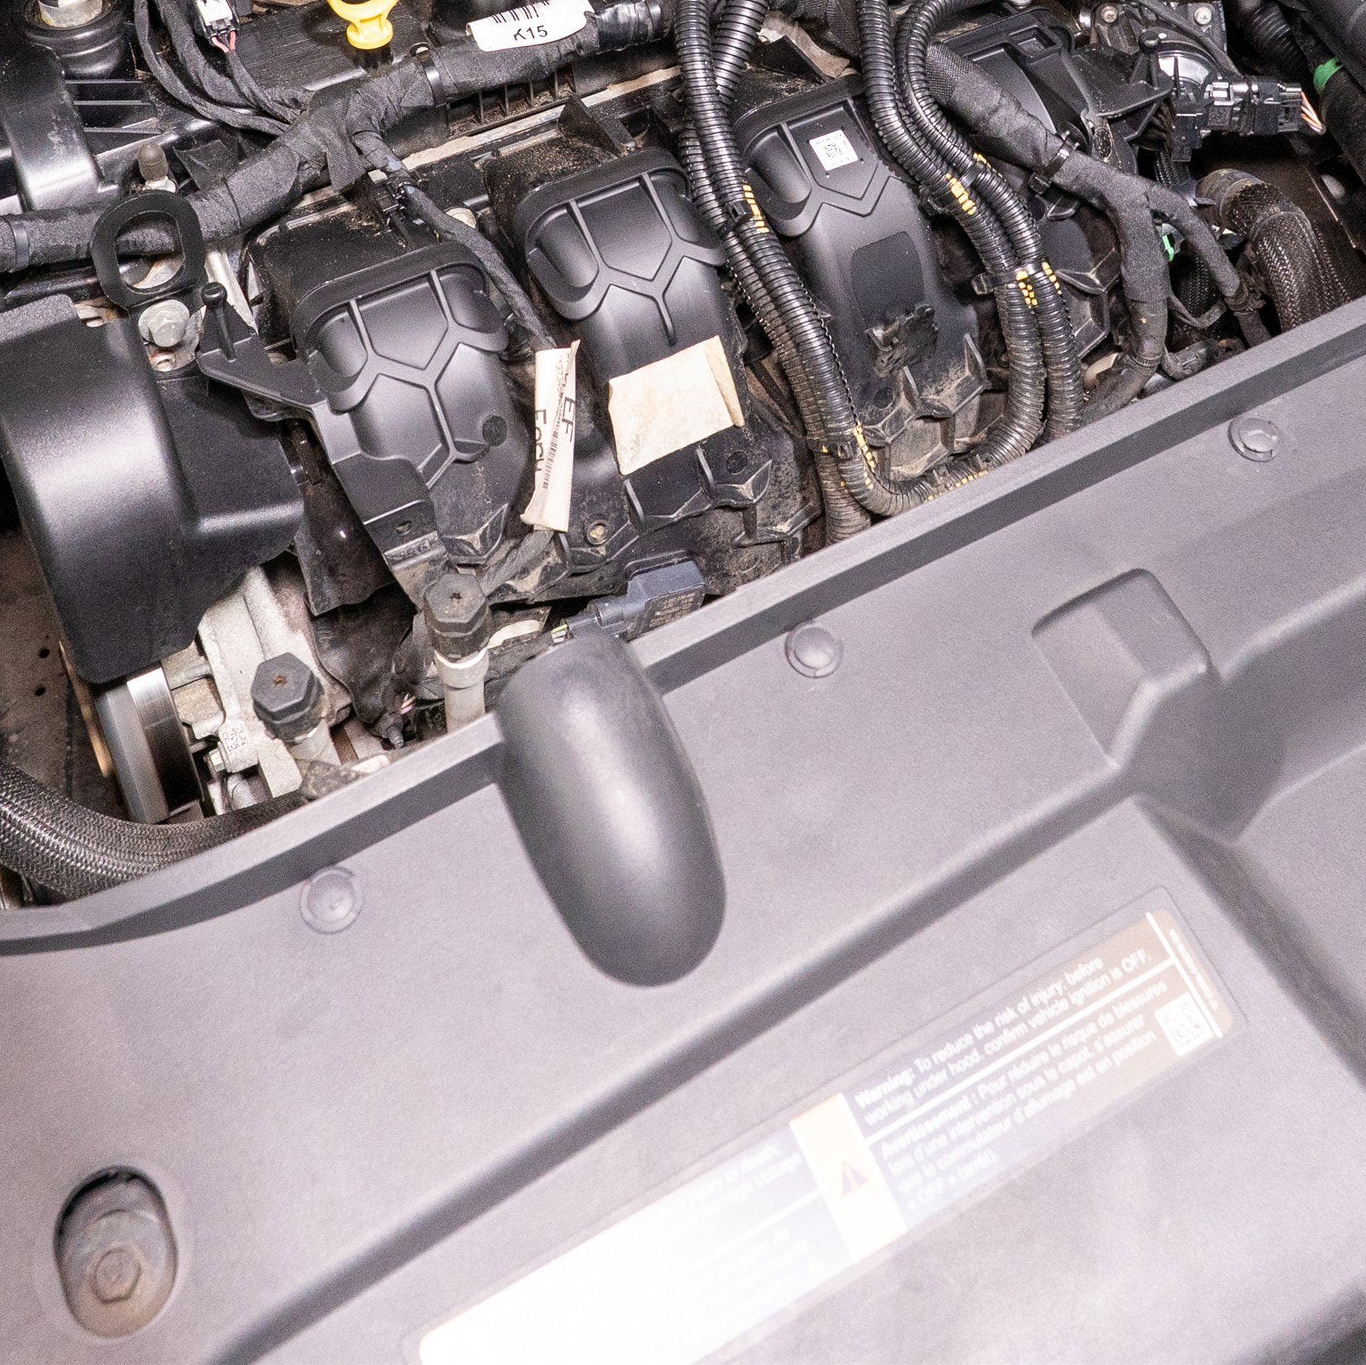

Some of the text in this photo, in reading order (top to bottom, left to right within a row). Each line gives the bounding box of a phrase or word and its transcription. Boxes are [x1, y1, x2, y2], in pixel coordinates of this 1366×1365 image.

[853, 1063, 917, 1113] Warning:
[913, 1054, 932, 1075] To
[929, 1029, 975, 1066] reduce
[971, 1016, 996, 1041] the
[992, 1003, 1018, 1028] risk
[1014, 995, 1033, 1015] of
[1063, 953, 1105, 986] before
[862, 1086, 916, 1131] working
[911, 1066, 950, 1098] under
[981, 1018, 1030, 1057] confirm
[1025, 994, 1071, 1030] vehicle
[1066, 970, 1114, 1009] ignition
[1107, 963, 1124, 981] is
[975, 1071, 1010, 1101] Pour
[1046, 1038, 1063, 1058] le
[1058, 1018, 1100, 1053] risque
[1094, 1007, 1116, 1030] de
